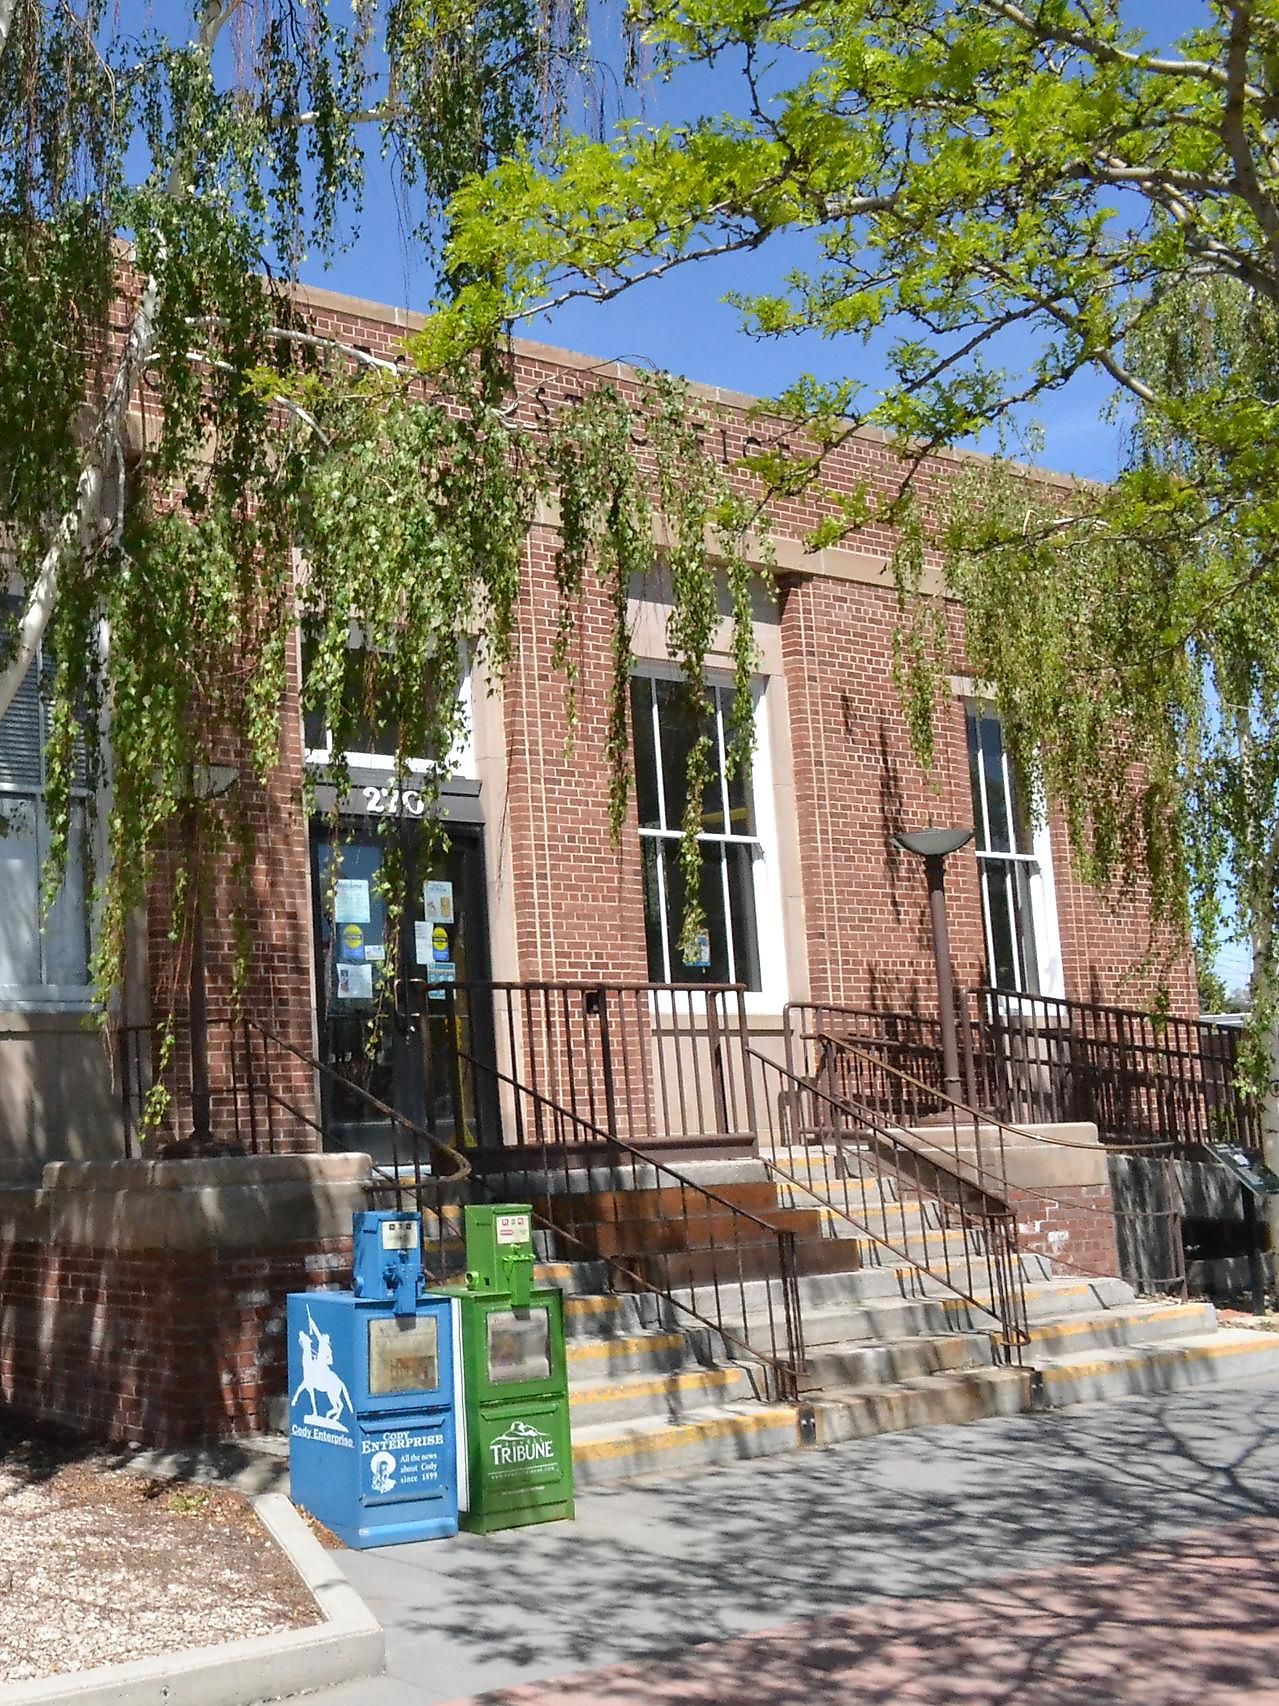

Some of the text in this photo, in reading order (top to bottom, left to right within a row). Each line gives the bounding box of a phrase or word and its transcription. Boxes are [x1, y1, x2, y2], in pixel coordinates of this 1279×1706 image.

[363, 786, 424, 815] 270
[291, 1424, 312, 1440] Cody
[382, 1431, 409, 1441] CODY
[361, 1434, 444, 1454] ENTERPRISE
[400, 1452, 438, 1463] All the news
[490, 1440, 554, 1465] TRIBUNE
[400, 1461, 438, 1473] about Cody
[400, 1475, 417, 1484] since
